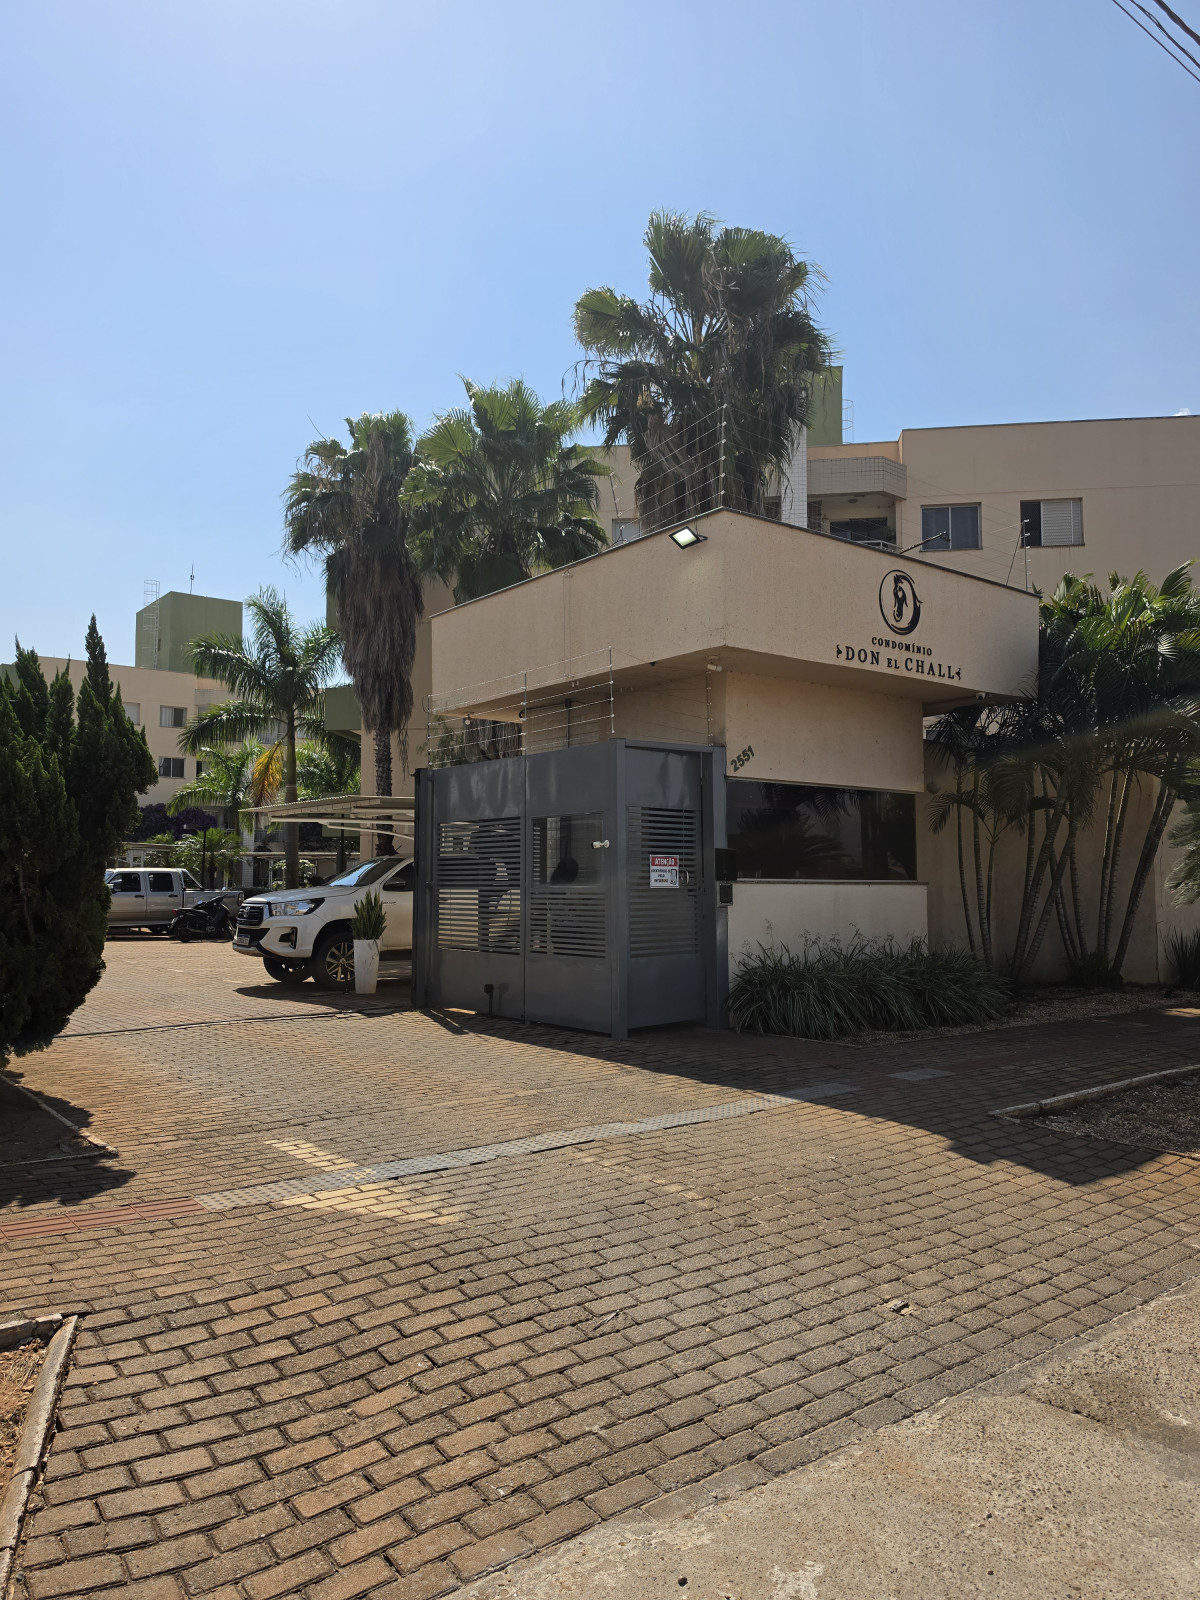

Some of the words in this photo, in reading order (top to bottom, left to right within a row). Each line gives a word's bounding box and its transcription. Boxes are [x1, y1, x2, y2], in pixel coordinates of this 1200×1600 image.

[871, 636, 932, 656] CONDOMÍNIO
[845, 645, 880, 665] DON
[887, 658, 900, 669] EL
[904, 657, 955, 680] CHALL
[730, 744, 755, 772] 2551
[654, 857, 675, 866] ATENÇÃO
